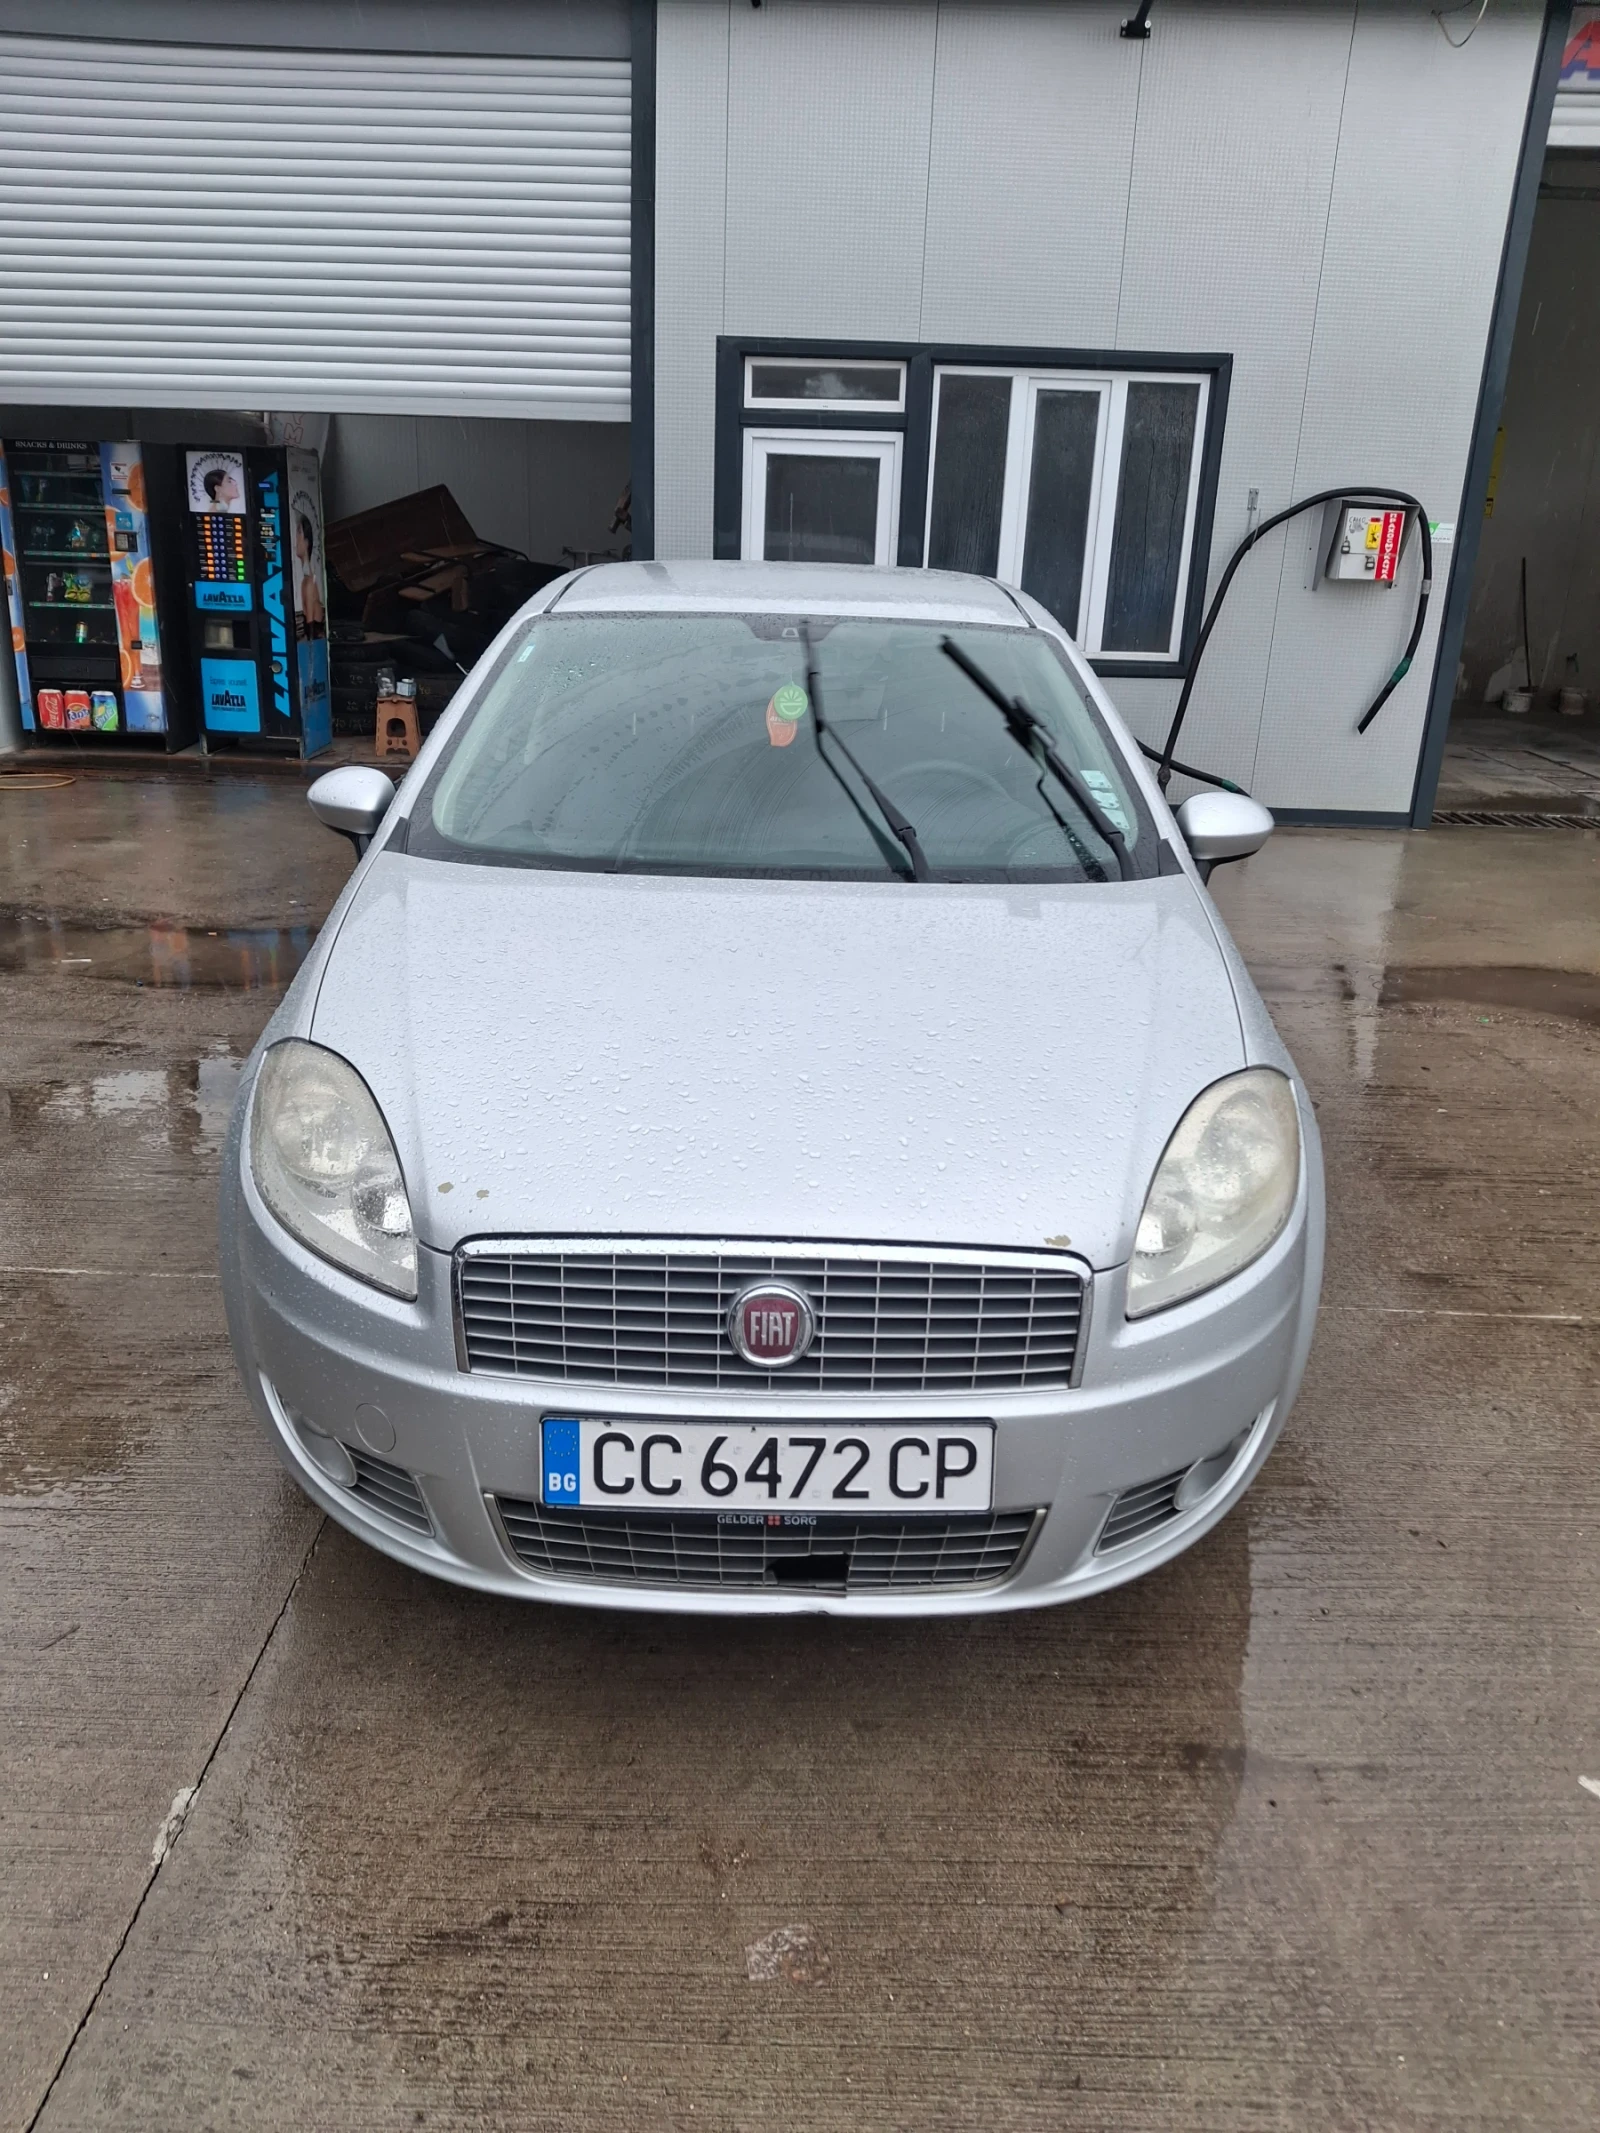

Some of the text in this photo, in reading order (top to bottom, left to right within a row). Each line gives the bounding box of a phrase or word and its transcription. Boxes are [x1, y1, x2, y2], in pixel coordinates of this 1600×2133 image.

[15, 440, 88, 450] SNACKS & DRINKS
[203, 591, 245, 604] LAVAZZA
[211, 690, 246, 707] LAVAZZA
[750, 1311, 795, 1347] FIAT
[593, 1432, 978, 1499] CC 6472 CP
[548, 1472, 577, 1492] BG
[717, 1514, 817, 1526] GELDER SORG
